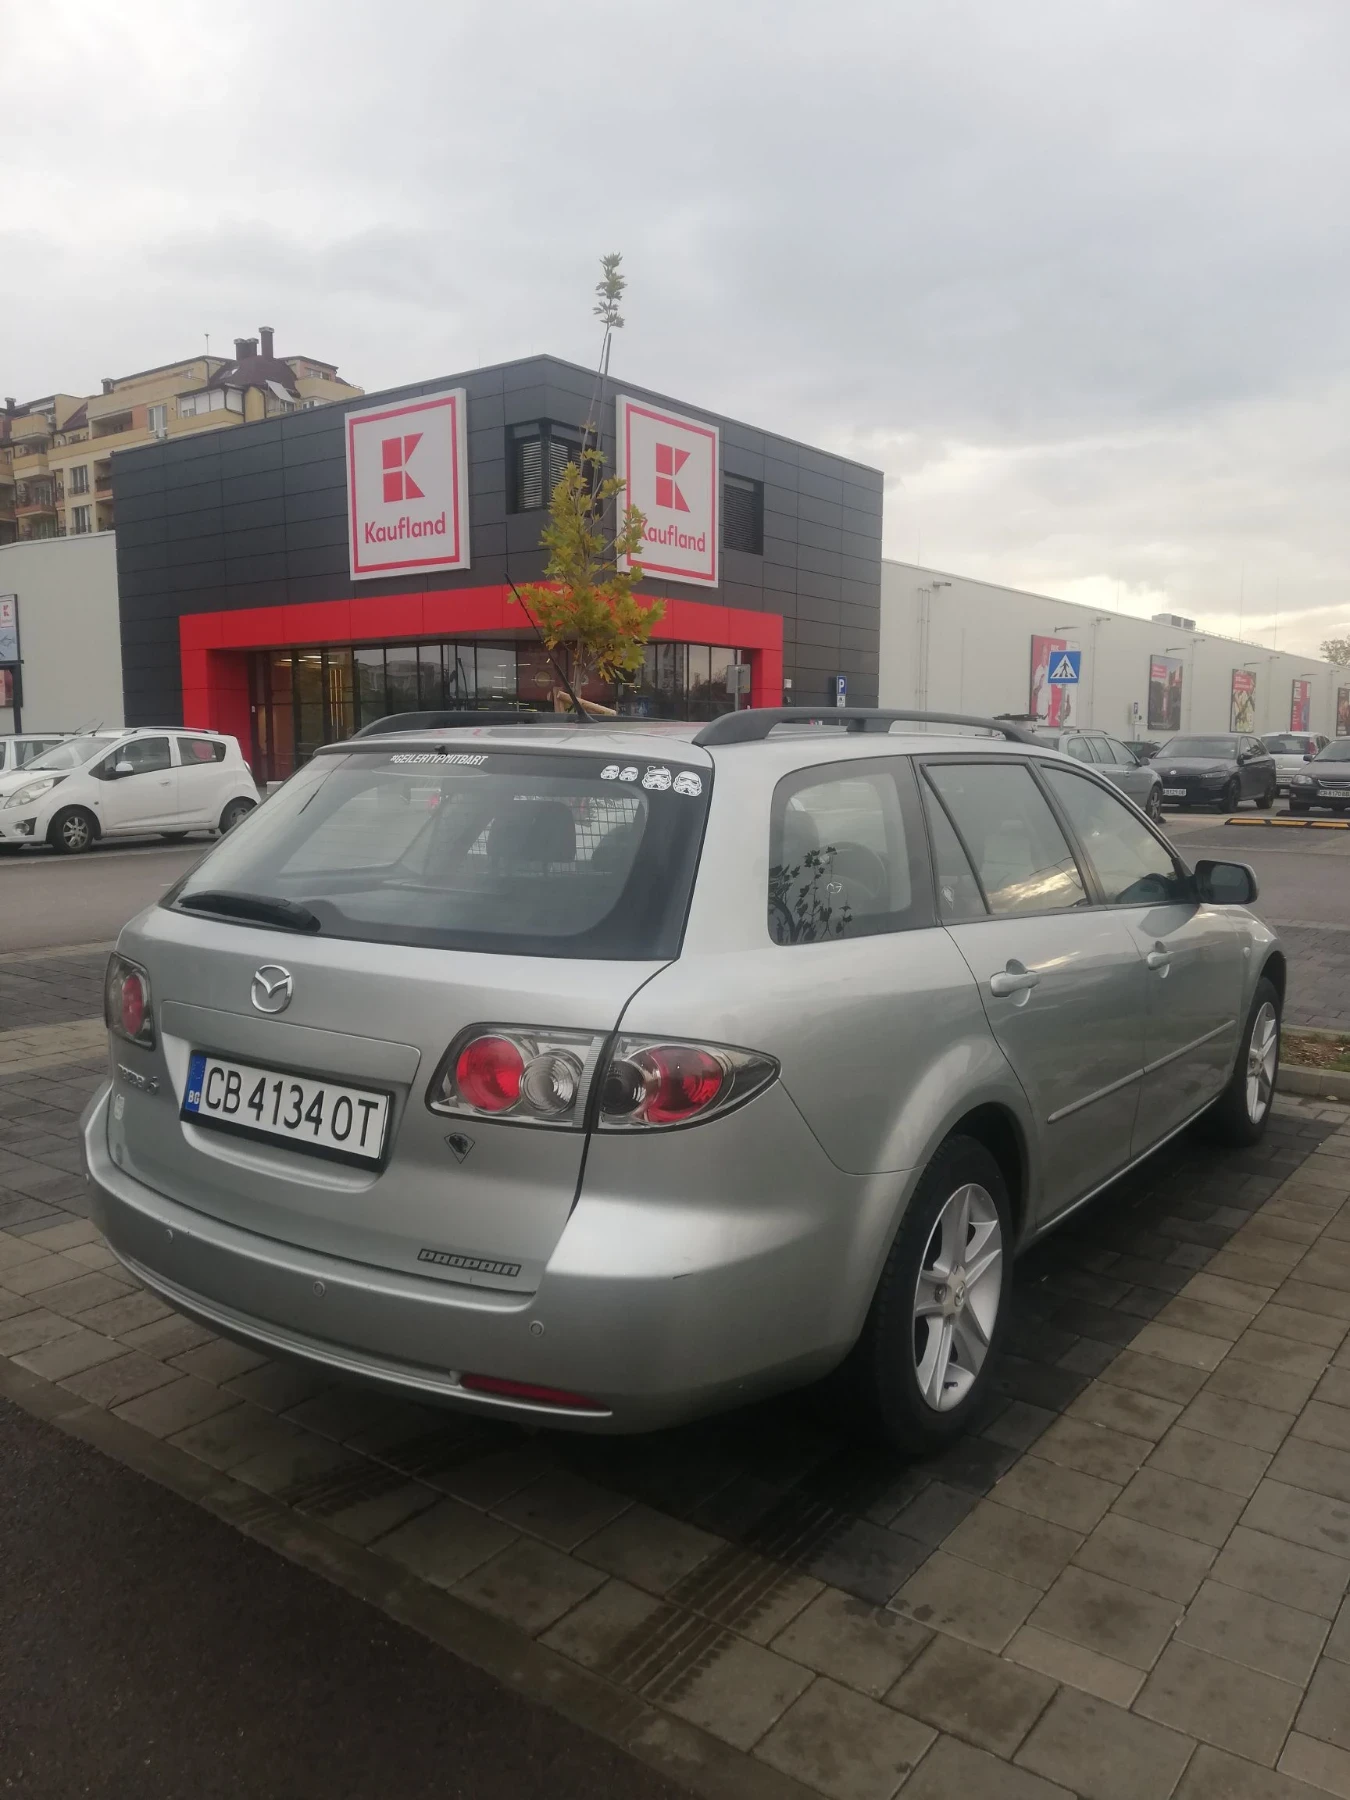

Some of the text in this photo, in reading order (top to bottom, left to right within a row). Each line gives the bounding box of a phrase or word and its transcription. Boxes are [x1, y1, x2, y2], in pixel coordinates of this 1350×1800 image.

[364, 511, 447, 544] Kaufland
[838, 678, 845, 693] P
[188, 1089, 201, 1104] BG
[205, 1066, 242, 1114] CB
[247, 1077, 325, 1136] 4134
[330, 1095, 379, 1147] OT
